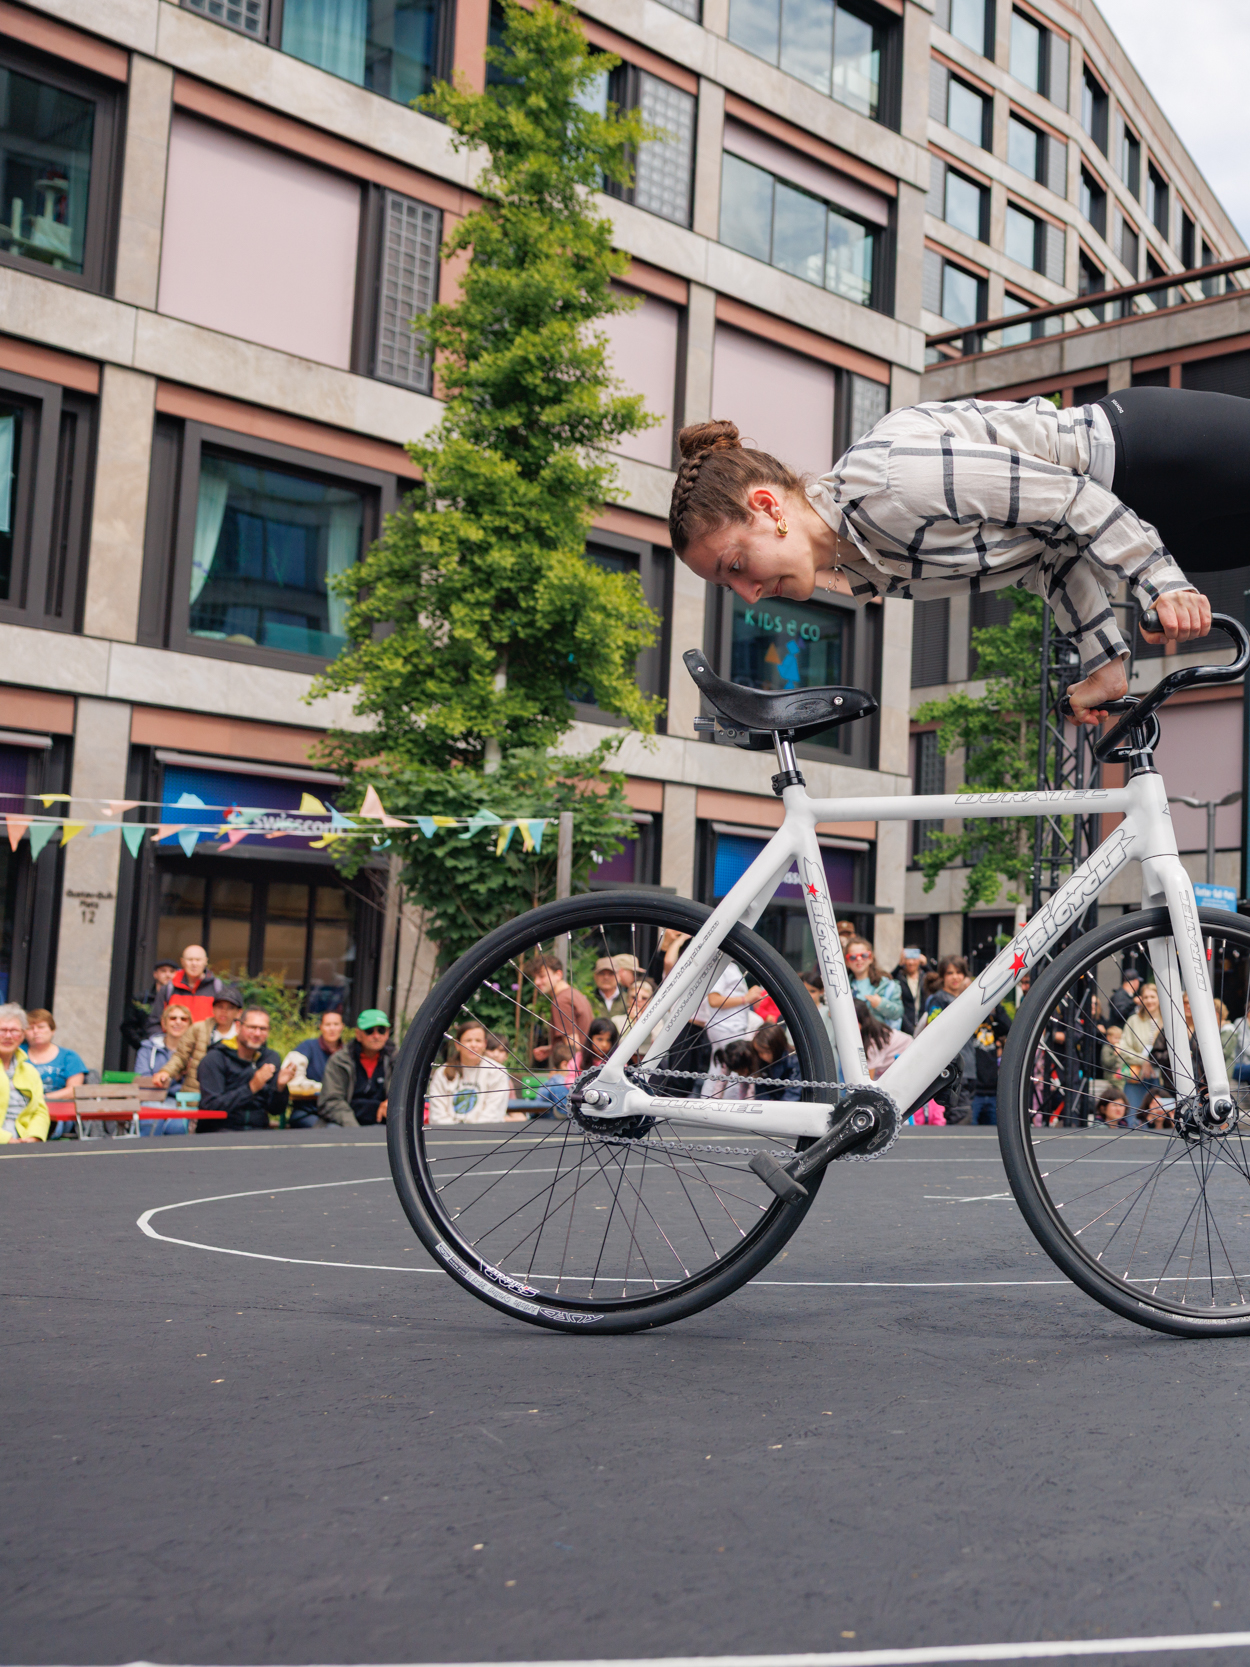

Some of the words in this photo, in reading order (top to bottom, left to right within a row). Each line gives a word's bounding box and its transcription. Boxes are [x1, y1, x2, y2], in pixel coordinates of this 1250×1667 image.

[745, 608, 782, 632] KIDS
[801, 623, 820, 641] CO
[955, 788, 1108, 804] DURATEC
[82, 910, 95, 924] 12
[1179, 889, 1207, 992] DURATEC
[650, 1099, 763, 1114] DURATEC
